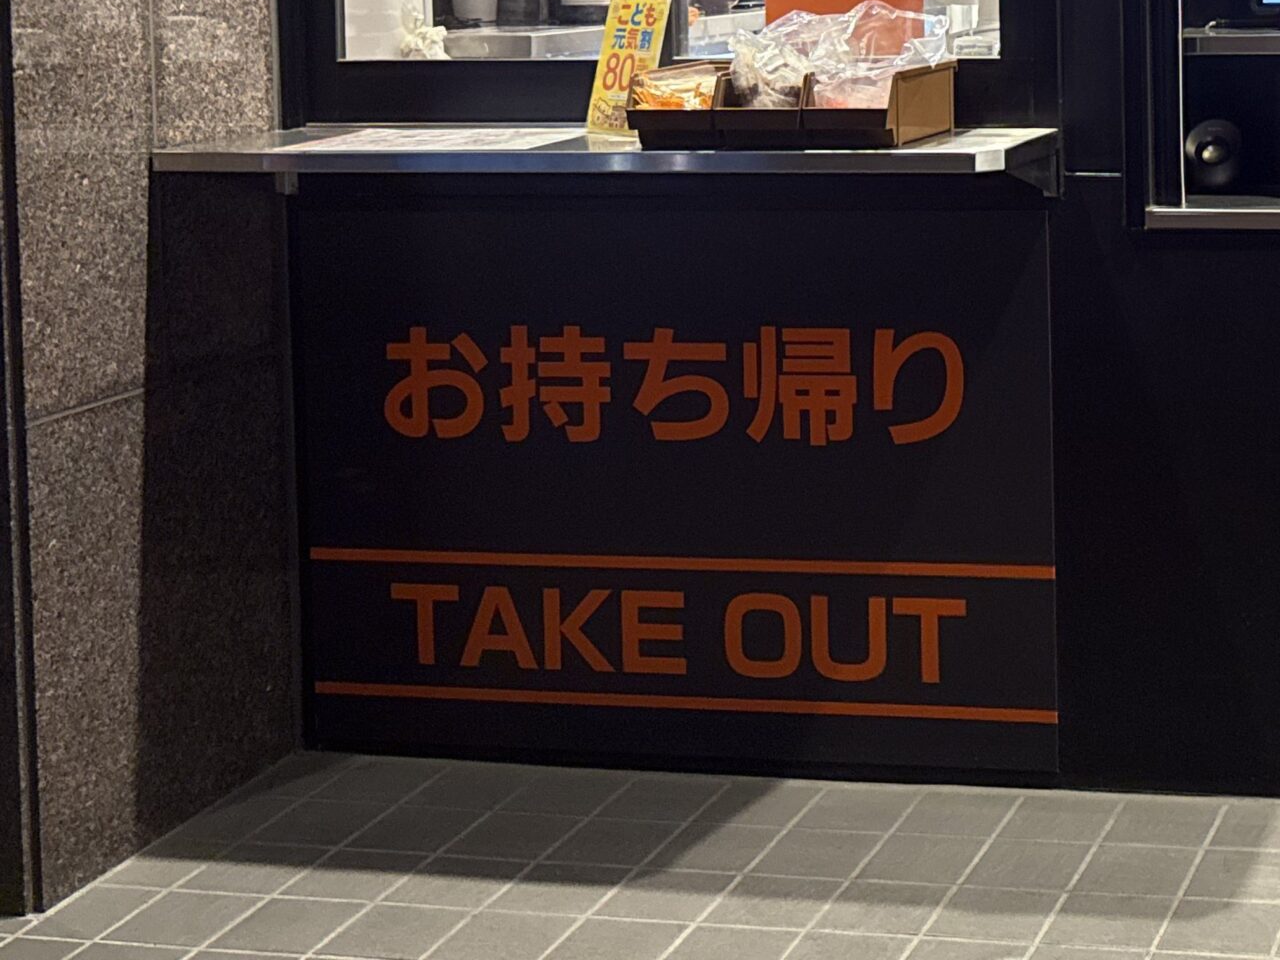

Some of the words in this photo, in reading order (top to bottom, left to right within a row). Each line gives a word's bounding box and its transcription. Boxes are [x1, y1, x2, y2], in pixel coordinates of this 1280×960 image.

[616, 3, 658, 26] こども
[611, 28, 655, 50] 元気割
[602, 52, 637, 91] 80
[384, 326, 965, 446] お持ち帰り
[390, 582, 688, 675] TAKE
[724, 592, 967, 684] OUT
